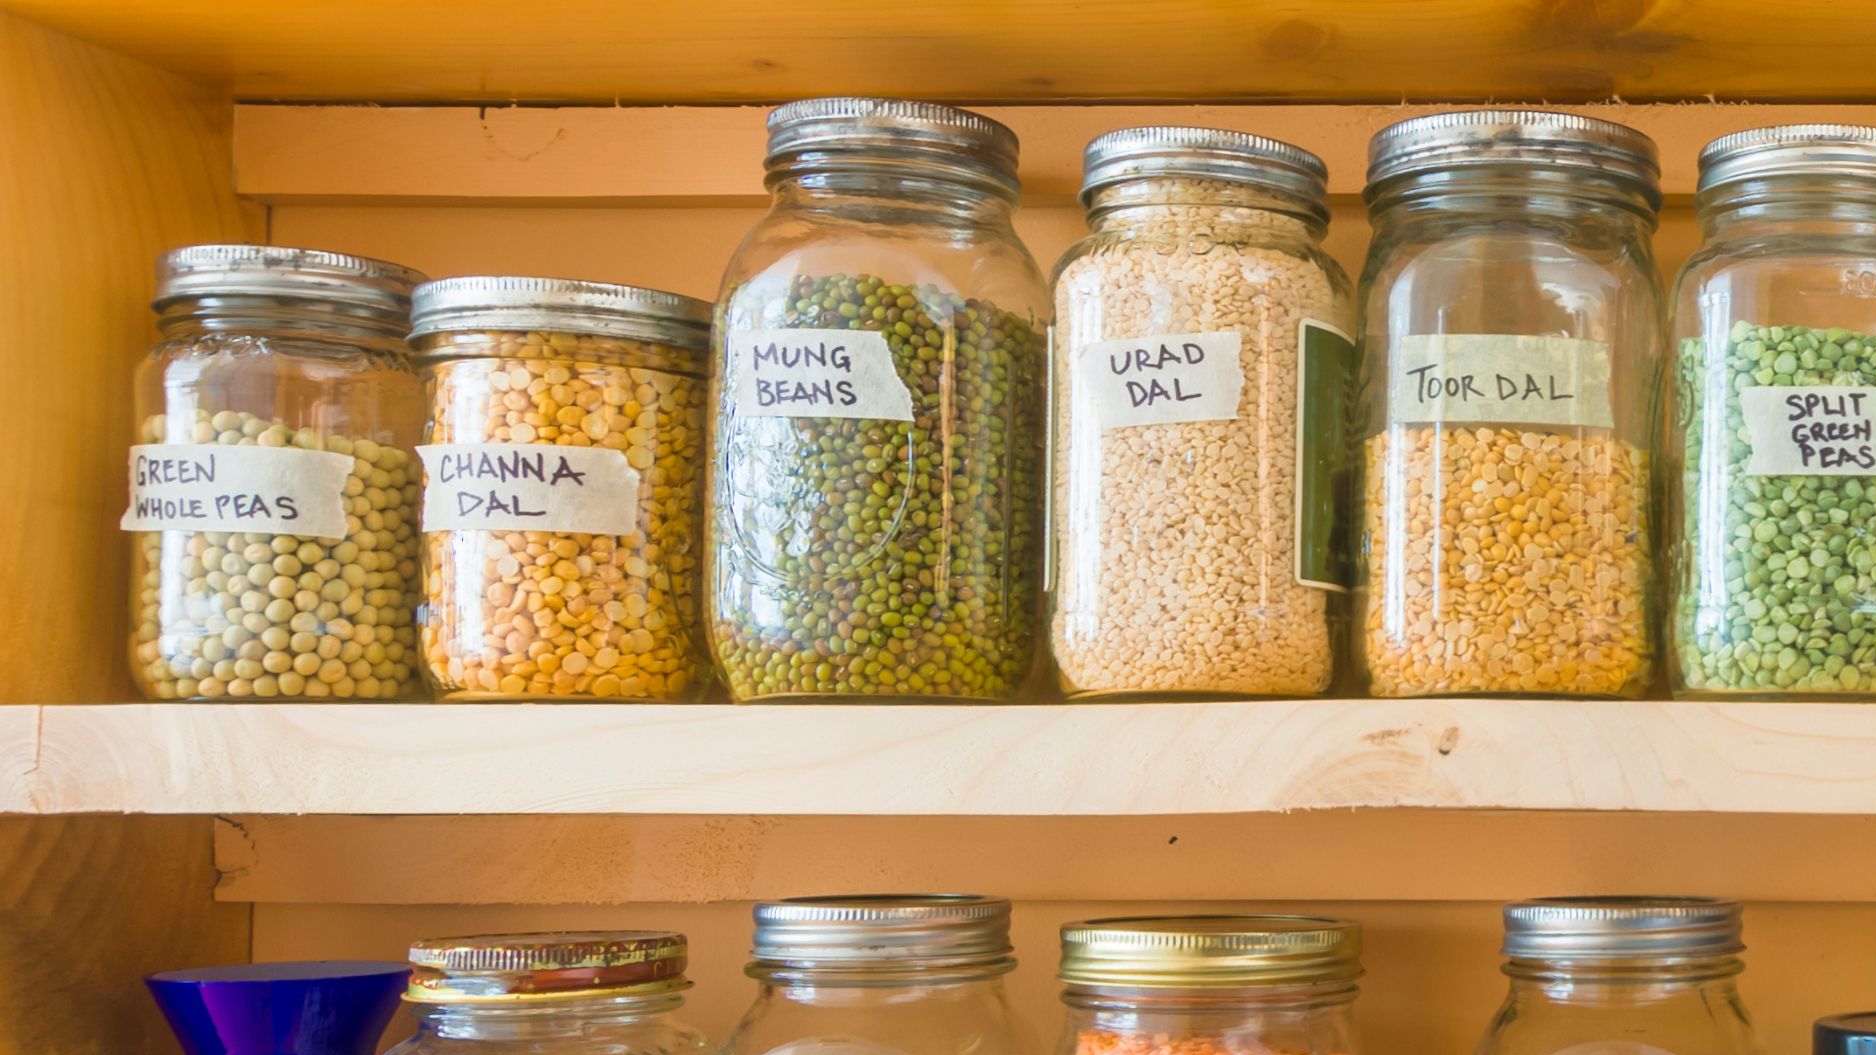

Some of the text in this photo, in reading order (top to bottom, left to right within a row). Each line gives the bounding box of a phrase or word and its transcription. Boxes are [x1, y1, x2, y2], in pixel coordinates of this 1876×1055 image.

[754, 343, 851, 373] MUNG
[1111, 343, 1204, 375] URAD
[757, 379, 857, 406] BEANS
[1126, 378, 1202, 407] DAL
[1407, 364, 1573, 403] TOOR DAL
[1786, 393, 1868, 422] SPLIT
[1791, 419, 1872, 446] GREEN
[136, 454, 215, 487] GREEN
[441, 451, 586, 486] CHANNA
[1800, 445, 1876, 469] PEAS
[136, 494, 299, 520] WHOLE PEAS
[458, 490, 547, 517] DAL
